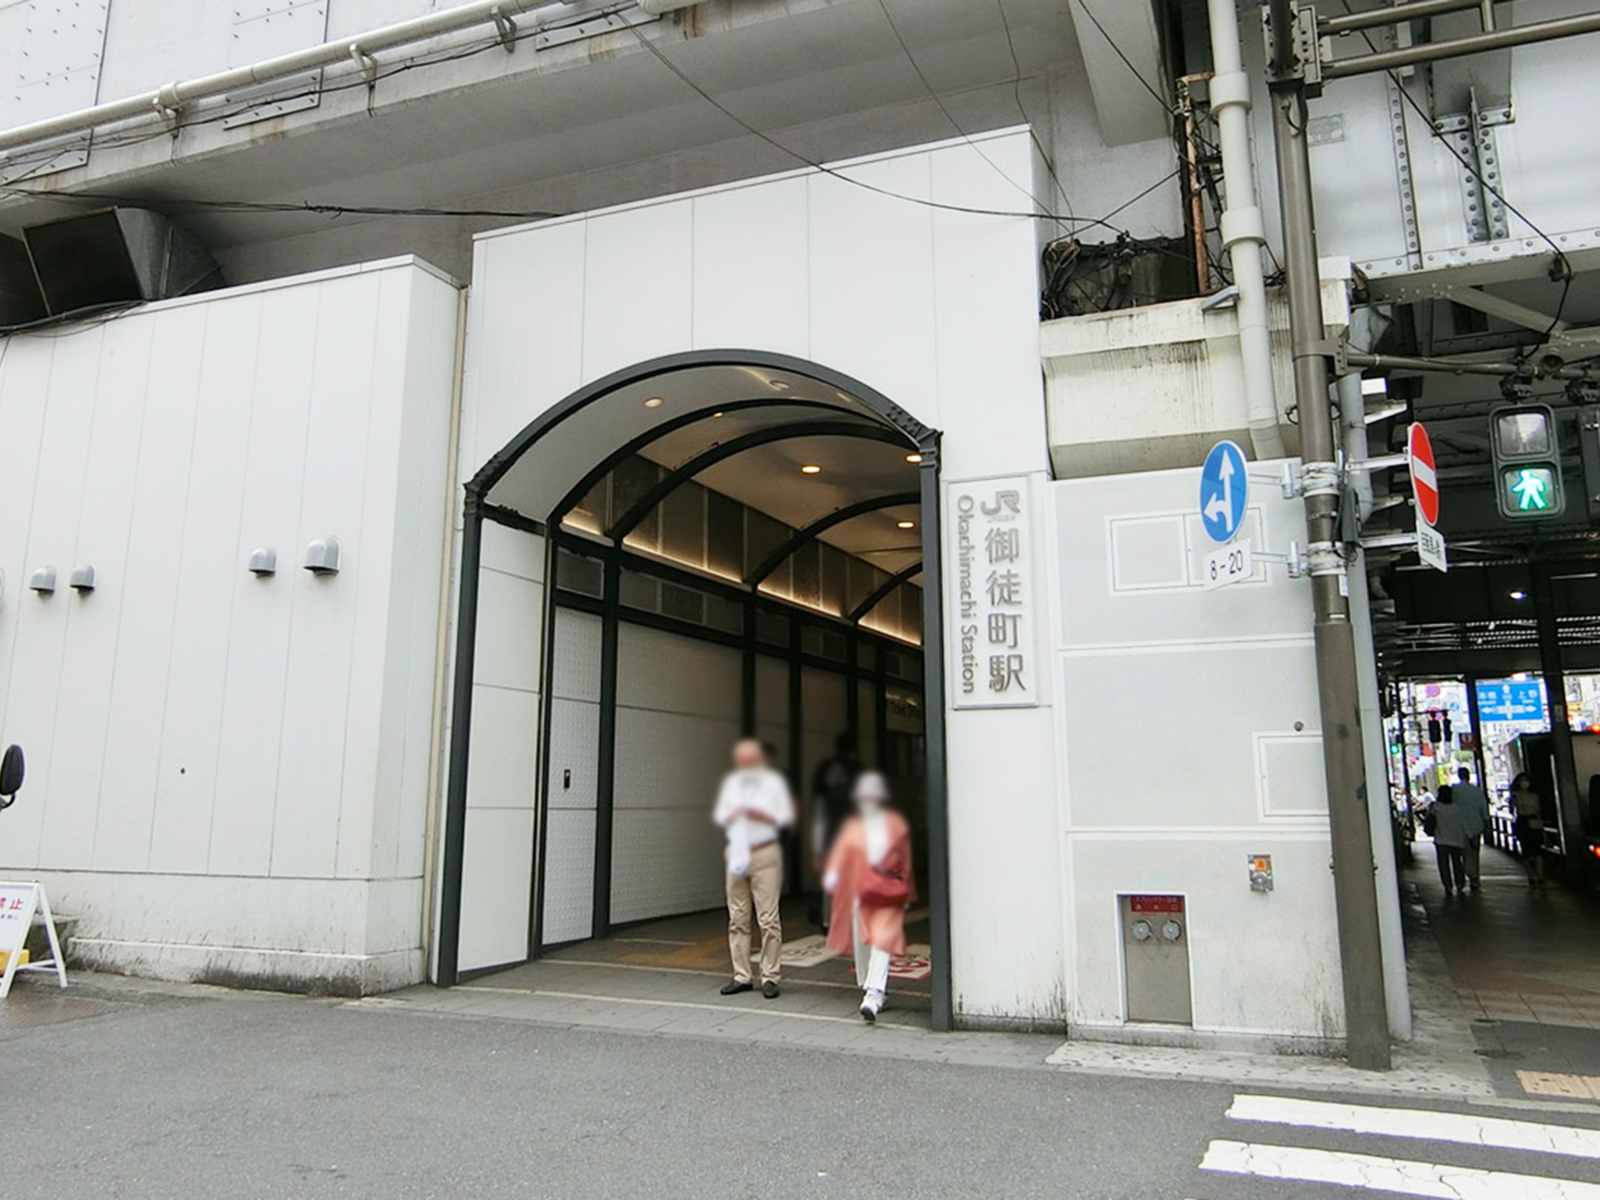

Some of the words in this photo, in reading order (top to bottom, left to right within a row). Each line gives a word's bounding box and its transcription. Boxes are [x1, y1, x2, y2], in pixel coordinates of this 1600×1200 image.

[980, 490, 1021, 516] JR
[957, 494, 977, 619] Okachimachi
[1210, 549, 1243, 581] 8-20
[985, 527, 1026, 692] 御徒町駅
[961, 624, 978, 694] Station
